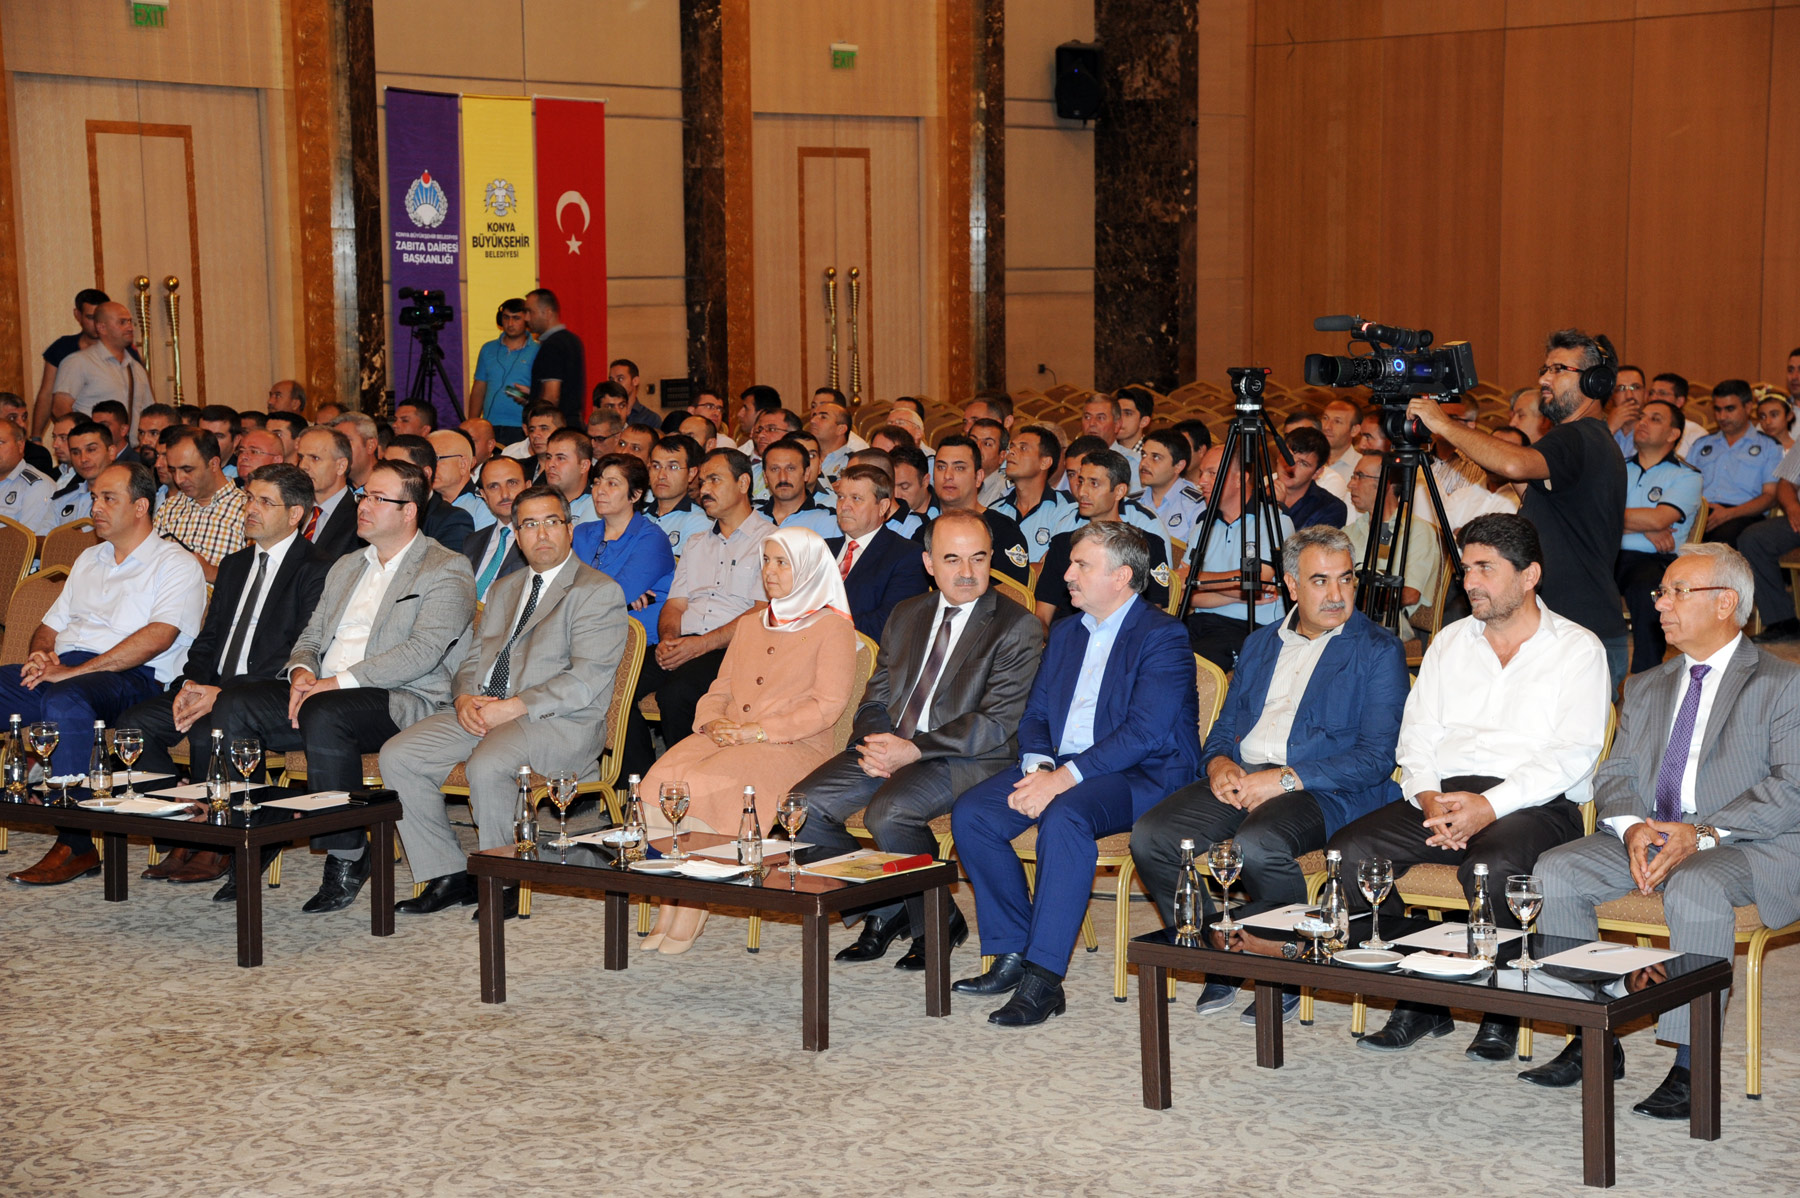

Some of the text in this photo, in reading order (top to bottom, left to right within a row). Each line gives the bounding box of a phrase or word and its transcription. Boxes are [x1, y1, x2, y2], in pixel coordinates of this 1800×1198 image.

[134, 3, 167, 27] EXIT
[487, 222, 516, 232] KONYA
[395, 240, 459, 253] ZABITA DAİRESİ
[472, 233, 530, 249] BÜYÜKŞEHİR
[403, 252, 454, 265] BAŞKANLIĞI
[485, 249, 519, 258] BELEDİYESİ
